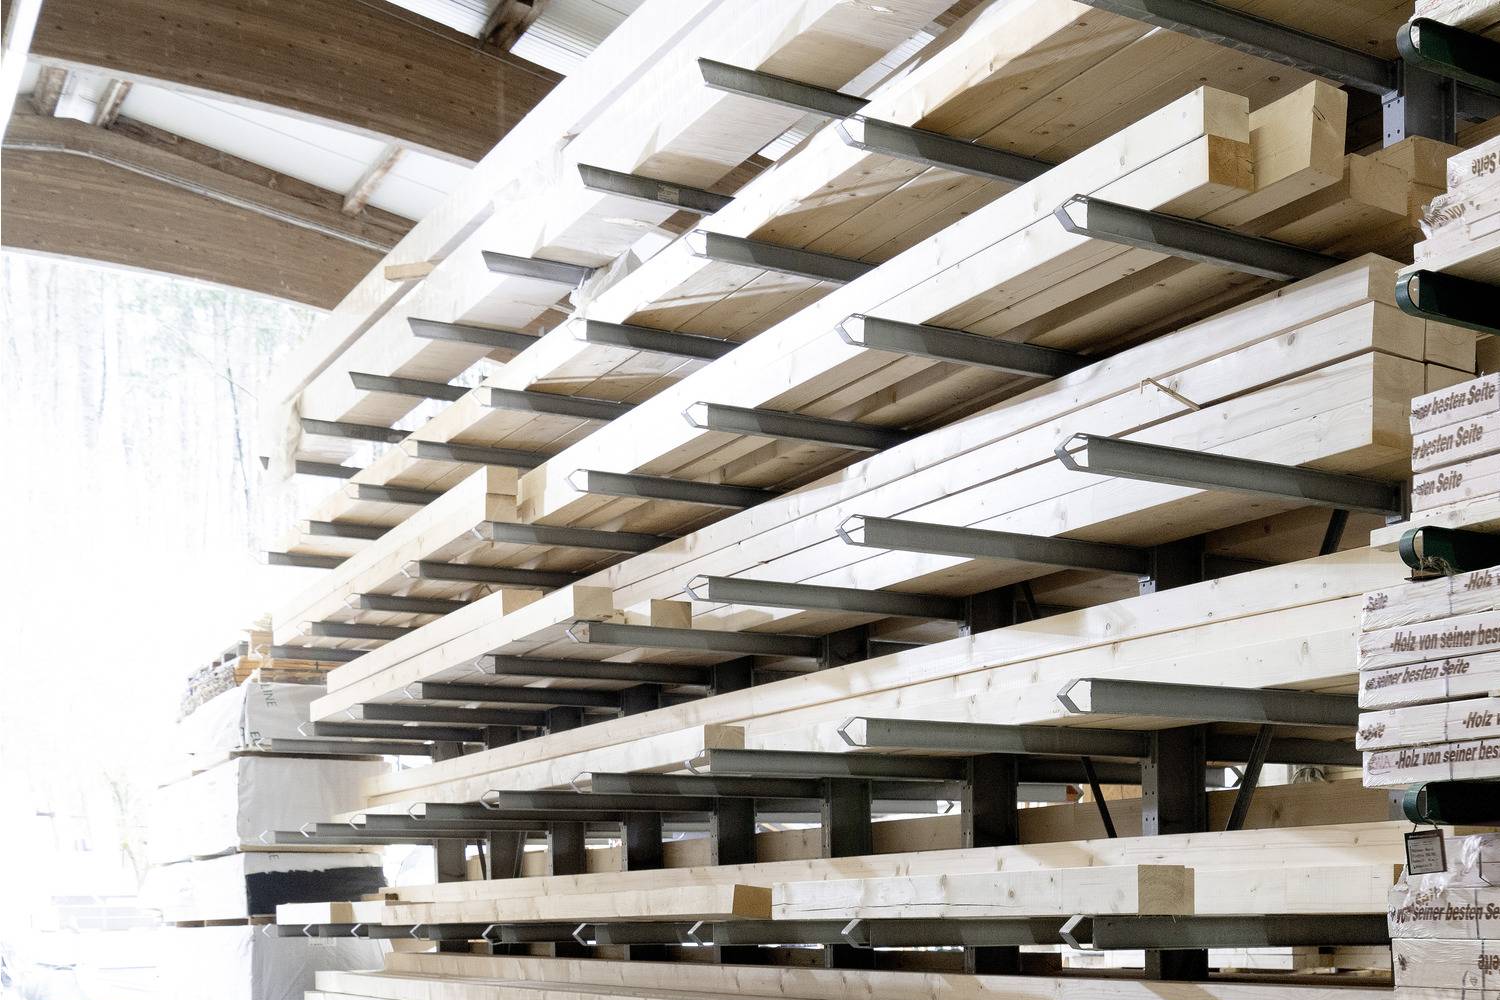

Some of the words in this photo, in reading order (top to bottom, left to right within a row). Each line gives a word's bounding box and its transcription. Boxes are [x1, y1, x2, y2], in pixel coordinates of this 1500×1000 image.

[1419, 632, 1437, 649] von
[1440, 626, 1473, 648] seiner
[1422, 750, 1440, 764] von
[1443, 745, 1476, 762] seiner
